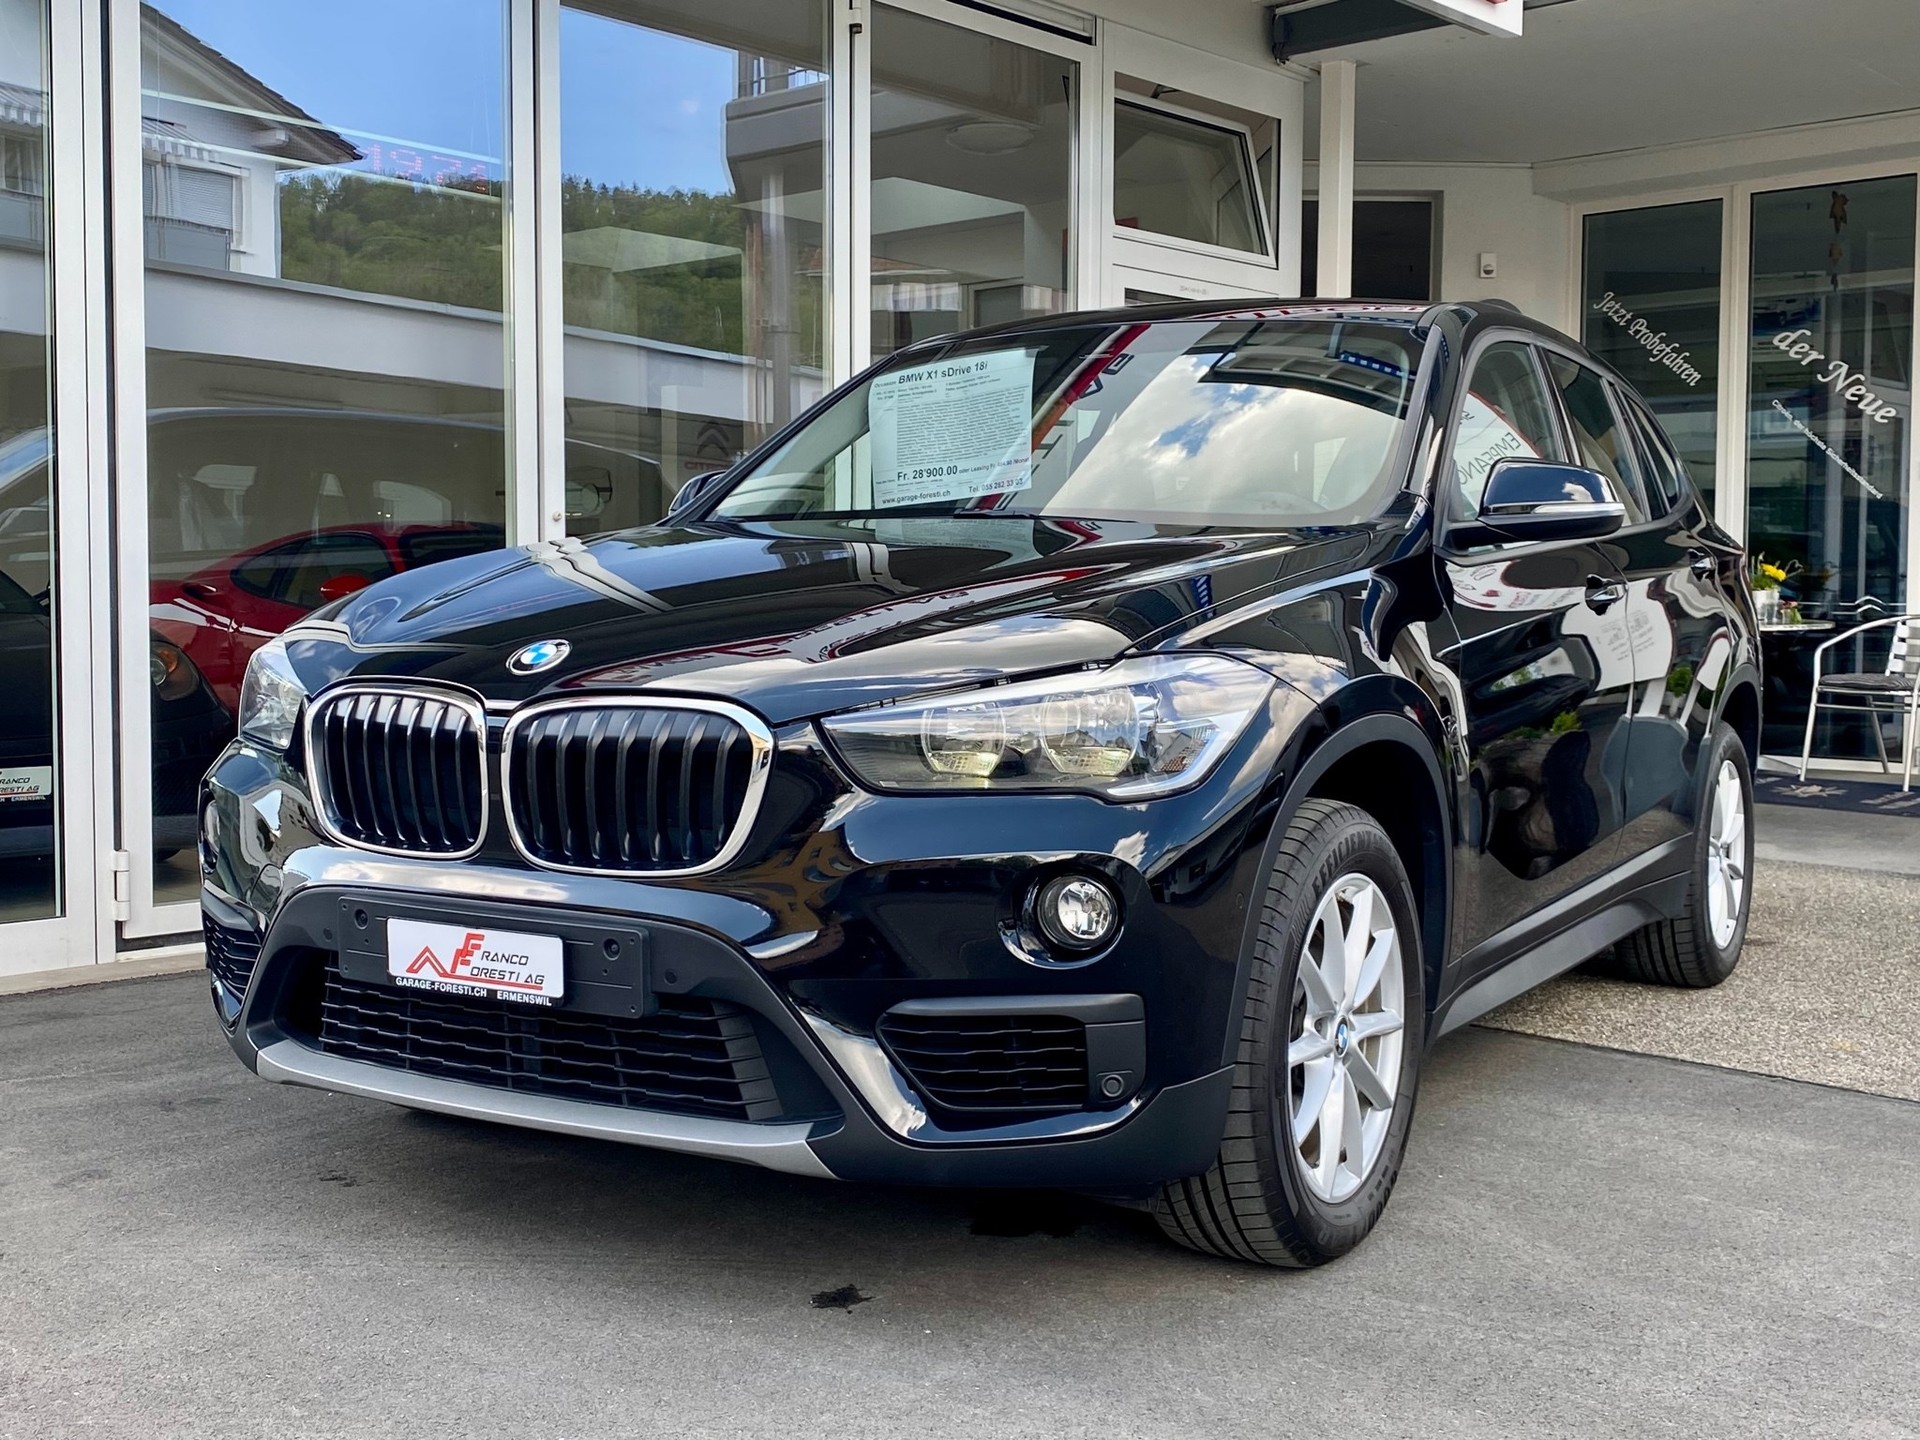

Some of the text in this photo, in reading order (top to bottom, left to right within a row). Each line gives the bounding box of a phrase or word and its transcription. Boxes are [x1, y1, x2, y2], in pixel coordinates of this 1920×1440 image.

[1593, 292, 1702, 387] Jetzt Probefahren
[898, 371, 924, 384] BMW
[925, 369, 939, 380] X1
[941, 364, 972, 377] sDrive
[974, 361, 988, 371] 18i
[1772, 329, 1897, 423] der Neue
[897, 471, 910, 482] Fr.
[912, 465, 958, 480] 28'900.00
[882, 490, 951, 504] www.garage-foresti.ch
[524, 973, 546, 985] AG
[395, 977, 553, 1007] GARAGE-FORESTI.CH ERMENSWIL
